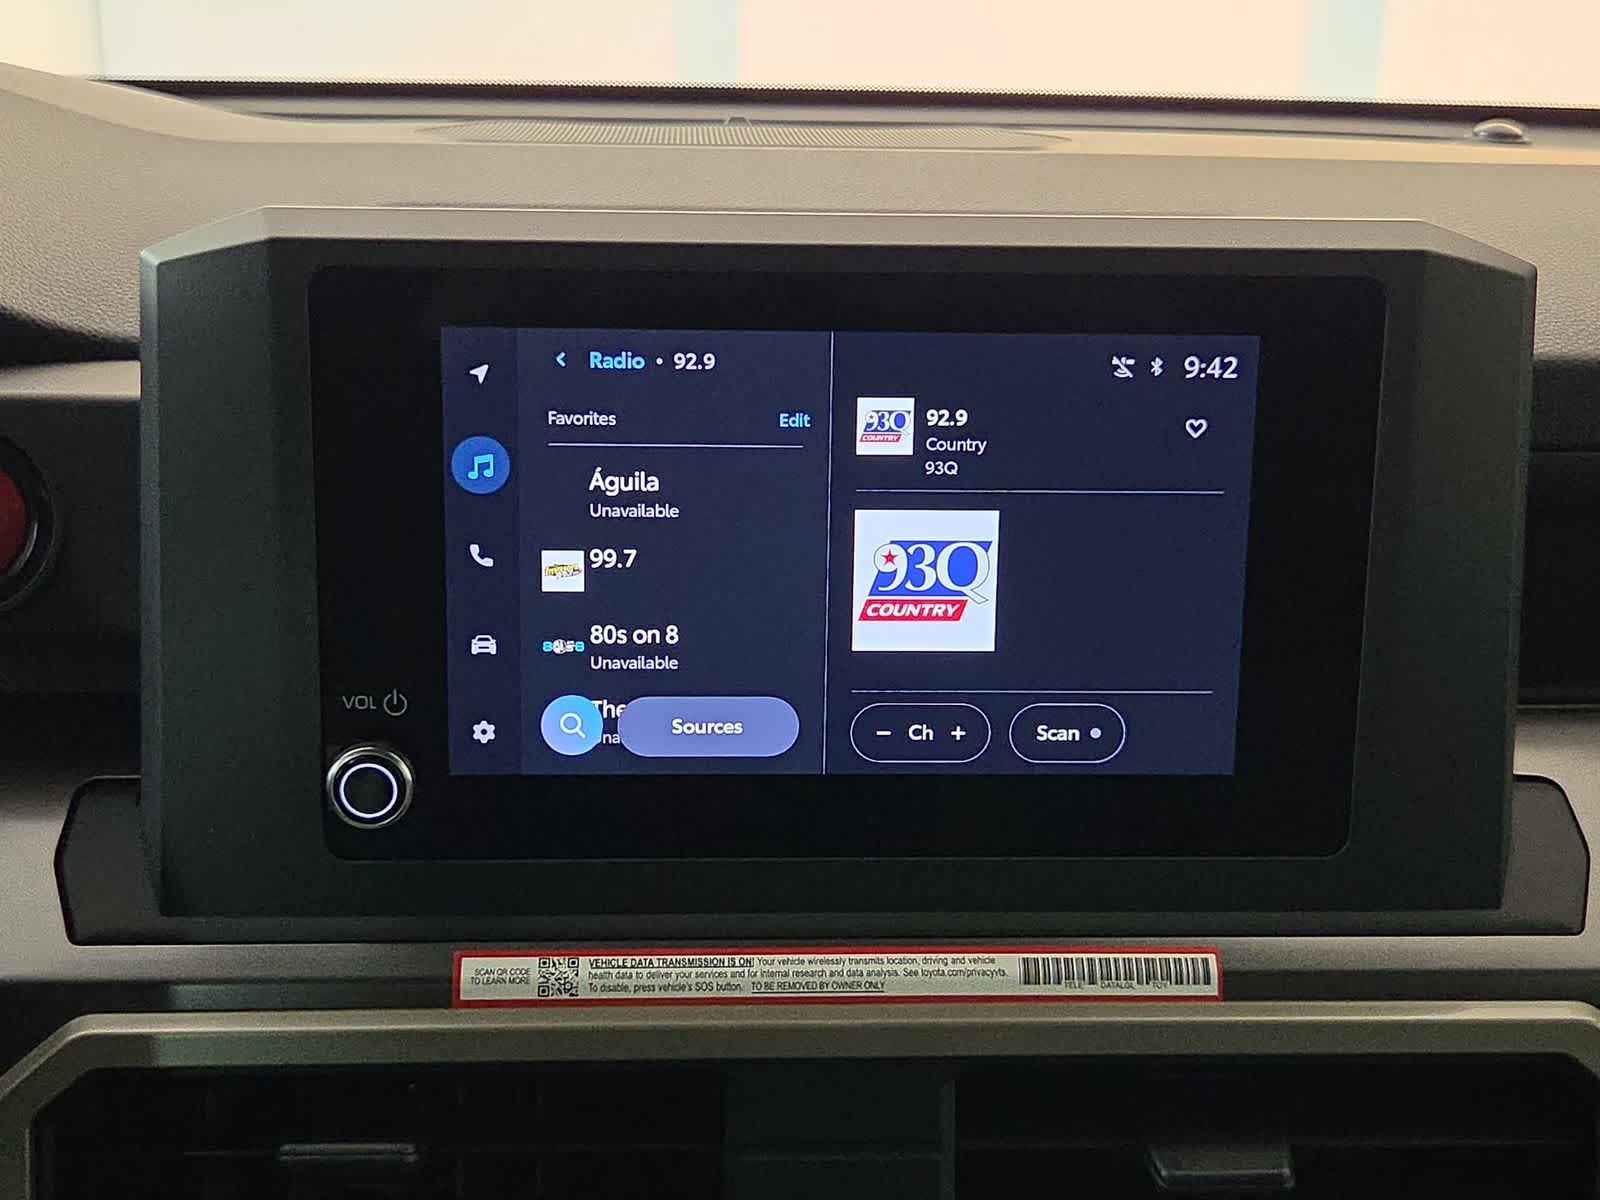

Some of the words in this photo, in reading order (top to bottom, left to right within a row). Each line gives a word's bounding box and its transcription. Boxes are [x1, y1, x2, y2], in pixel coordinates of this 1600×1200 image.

[588, 351, 646, 370] Radio
[673, 352, 717, 371] 92.9
[1183, 356, 1239, 379] 9:42
[547, 410, 617, 427] Favorites
[779, 413, 811, 428] Edit
[865, 410, 912, 435] 93Q
[926, 409, 968, 427] 92.9
[925, 437, 987, 455] Country
[925, 461, 959, 476] 93Q
[588, 467, 660, 497] Águila
[589, 503, 680, 519] Unavailable
[589, 549, 638, 569] 99.7
[873, 541, 991, 604] 93Q
[866, 603, 961, 617] COUNTRY
[589, 625, 628, 644] 80s
[632, 629, 661, 645] on
[665, 625, 680, 644] 8
[590, 656, 680, 671] Unavailable
[342, 695, 377, 710] VOL
[671, 717, 744, 736] Sources
[908, 725, 934, 741] Ch
[1036, 725, 1080, 742] Scan
[589, 958, 628, 967] VEHICLE
[631, 958, 654, 967] DATA
[656, 957, 725, 967] TRANSMISSION
[727, 957, 737, 967] IS
[757, 957, 775, 966] Your
[778, 957, 805, 966] vehicle
[808, 957, 845, 967] wirelessly
[848, 957, 884, 965] transmits
[922, 956, 948, 966] driving
[951, 956, 965, 965] and
[968, 956, 996, 965] vehicle
[474, 968, 495, 976] SCAN
[509, 968, 531, 976] CODE
[588, 970, 613, 980] health
[615, 970, 633, 980] data
[636, 970, 643, 980] to
[646, 970, 673, 980] deliver
[675, 971, 692, 981] your
[695, 970, 728, 979] services
[730, 969, 745, 978] and
[747, 968, 757, 978] for
[760, 968, 790, 978] internal
[792, 968, 827, 978] research
[829, 968, 844, 978] and
[846, 968, 863, 977] data
[903, 967, 919, 977] See
[471, 976, 480, 984] TO
[482, 976, 507, 985] LEARN
[508, 976, 531, 985] MORE
[588, 982, 598, 993] To
[633, 983, 656, 994] press
[658, 982, 693, 993] vehicle's
[695, 982, 714, 992] SOS
[751, 982, 762, 991] TO
[764, 982, 775, 991] BE
[776, 982, 818, 991] REMOVED
[820, 982, 829, 990] BY
[831, 981, 861, 990] OWNER
[863, 981, 885, 990] ONLY
